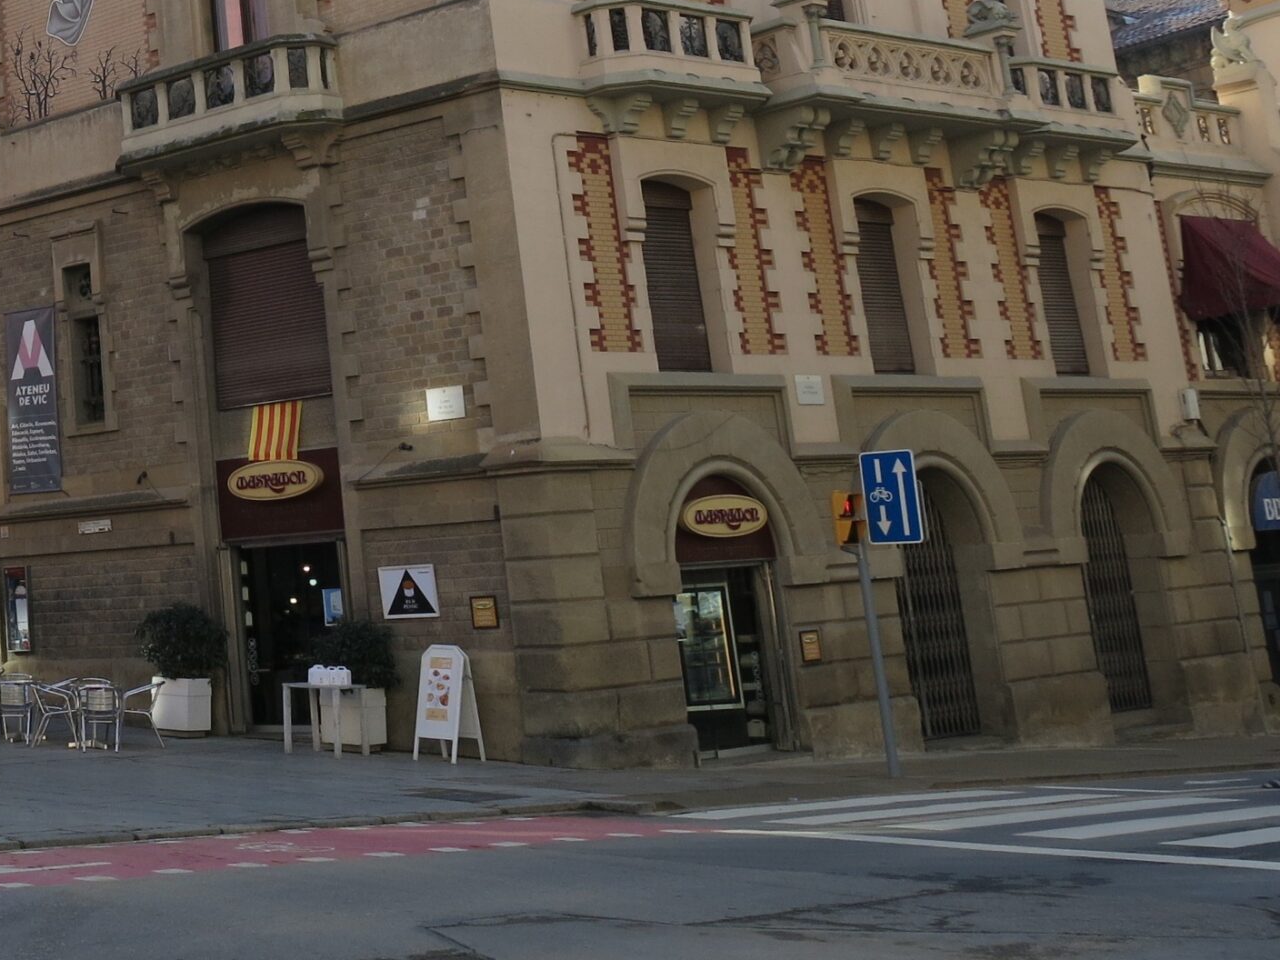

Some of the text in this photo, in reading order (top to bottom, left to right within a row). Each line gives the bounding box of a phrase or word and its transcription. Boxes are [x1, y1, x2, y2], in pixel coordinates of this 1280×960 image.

[15, 383, 50, 396] ATENEU
[18, 394, 48, 406] DE VIC
